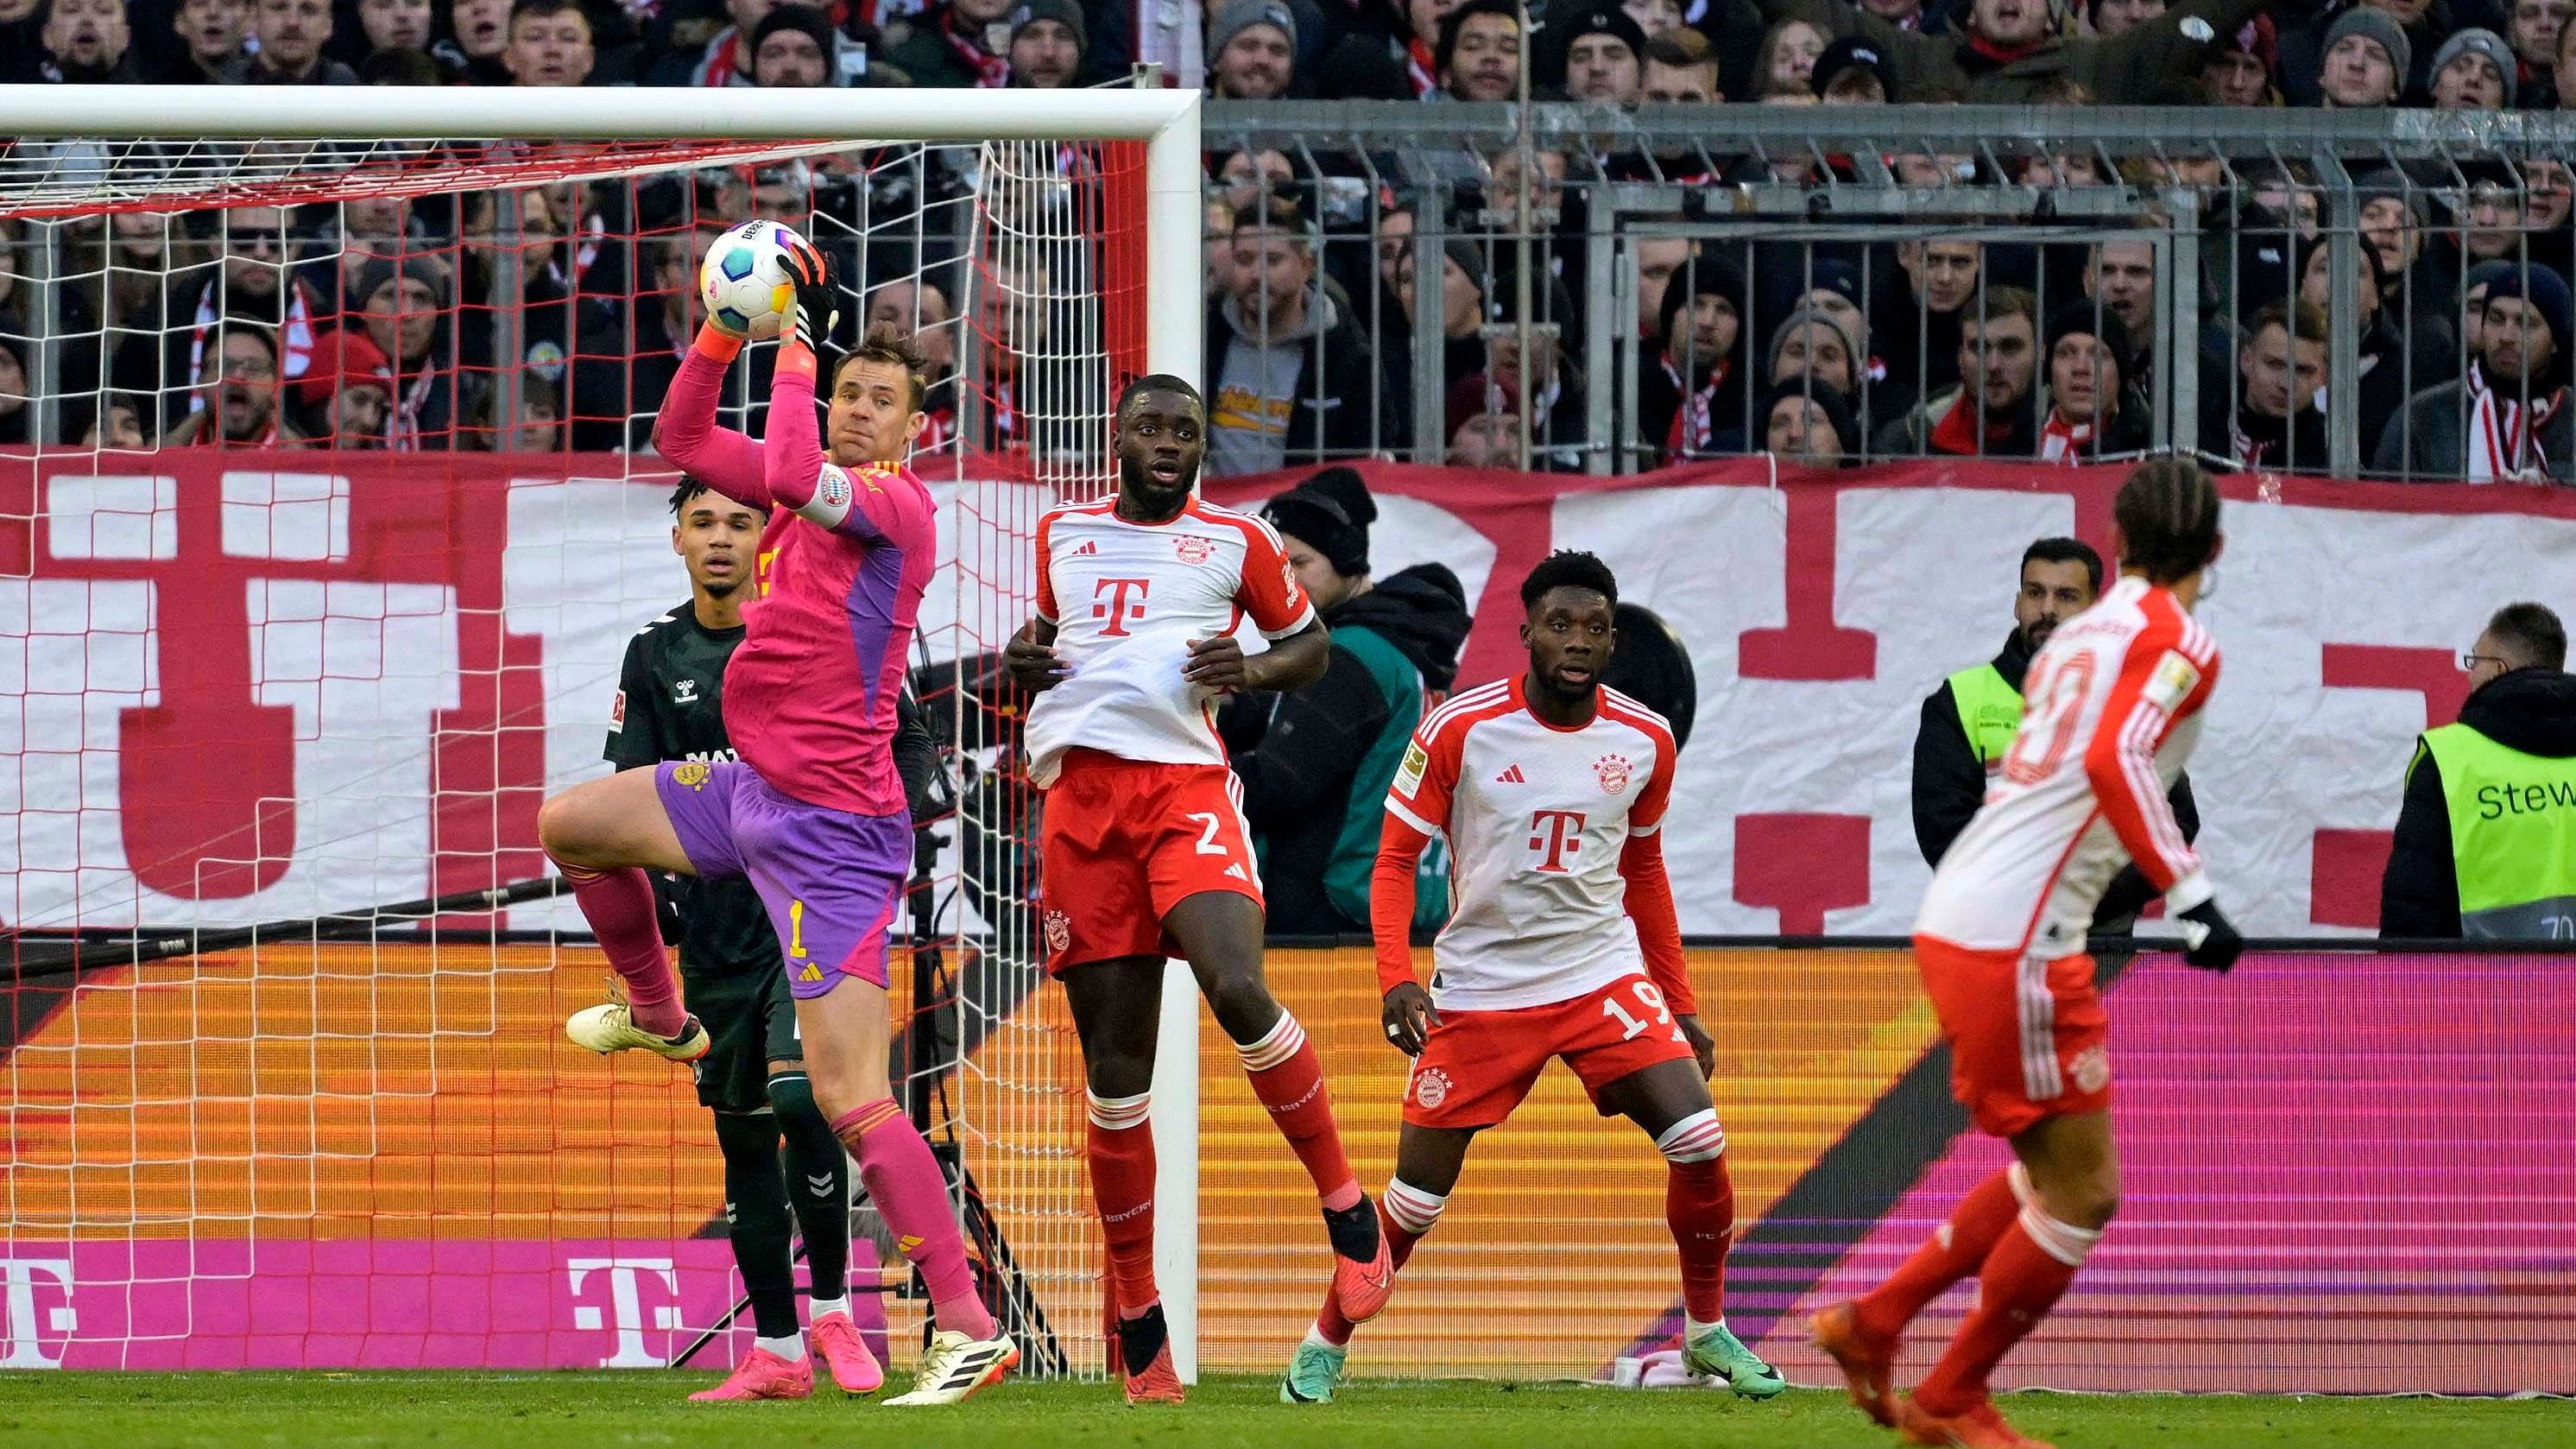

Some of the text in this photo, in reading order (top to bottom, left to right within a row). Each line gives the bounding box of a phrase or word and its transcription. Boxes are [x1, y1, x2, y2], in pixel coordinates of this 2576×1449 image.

[1185, 812, 1228, 856] 2
[789, 899, 807, 958] 1
[1603, 981, 1670, 1041] 19
